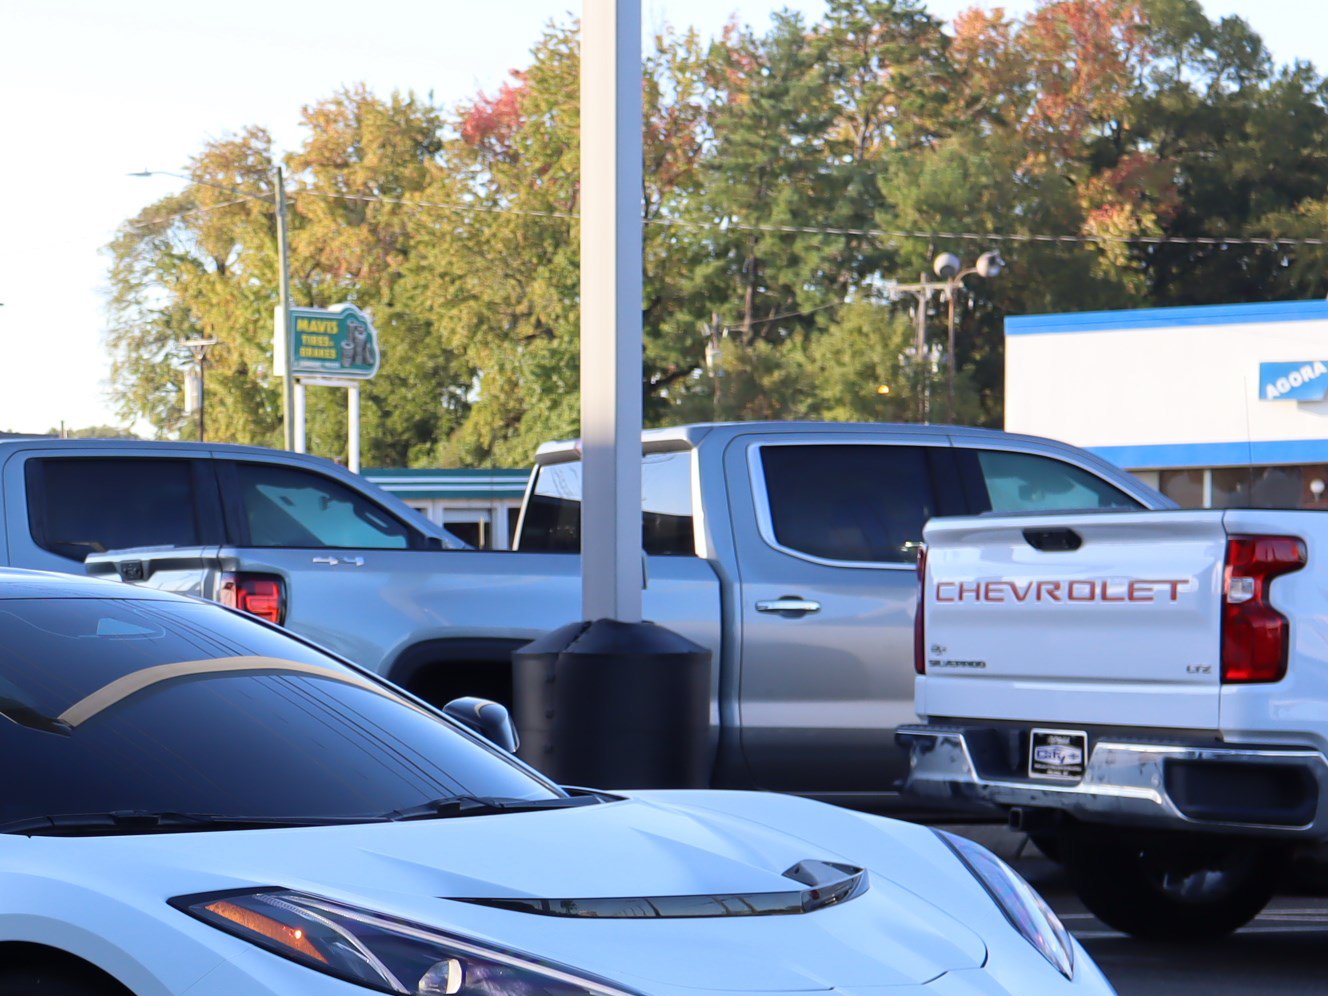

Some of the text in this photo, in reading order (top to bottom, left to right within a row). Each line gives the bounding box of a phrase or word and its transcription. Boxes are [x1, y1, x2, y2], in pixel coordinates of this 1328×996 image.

[296, 318, 339, 334] MAVIS
[299, 347, 337, 359] BRAKES
[1265, 361, 1328, 400] AGORA
[936, 579, 1190, 603] CHEVROLET
[1186, 664, 1213, 675] LTZ
